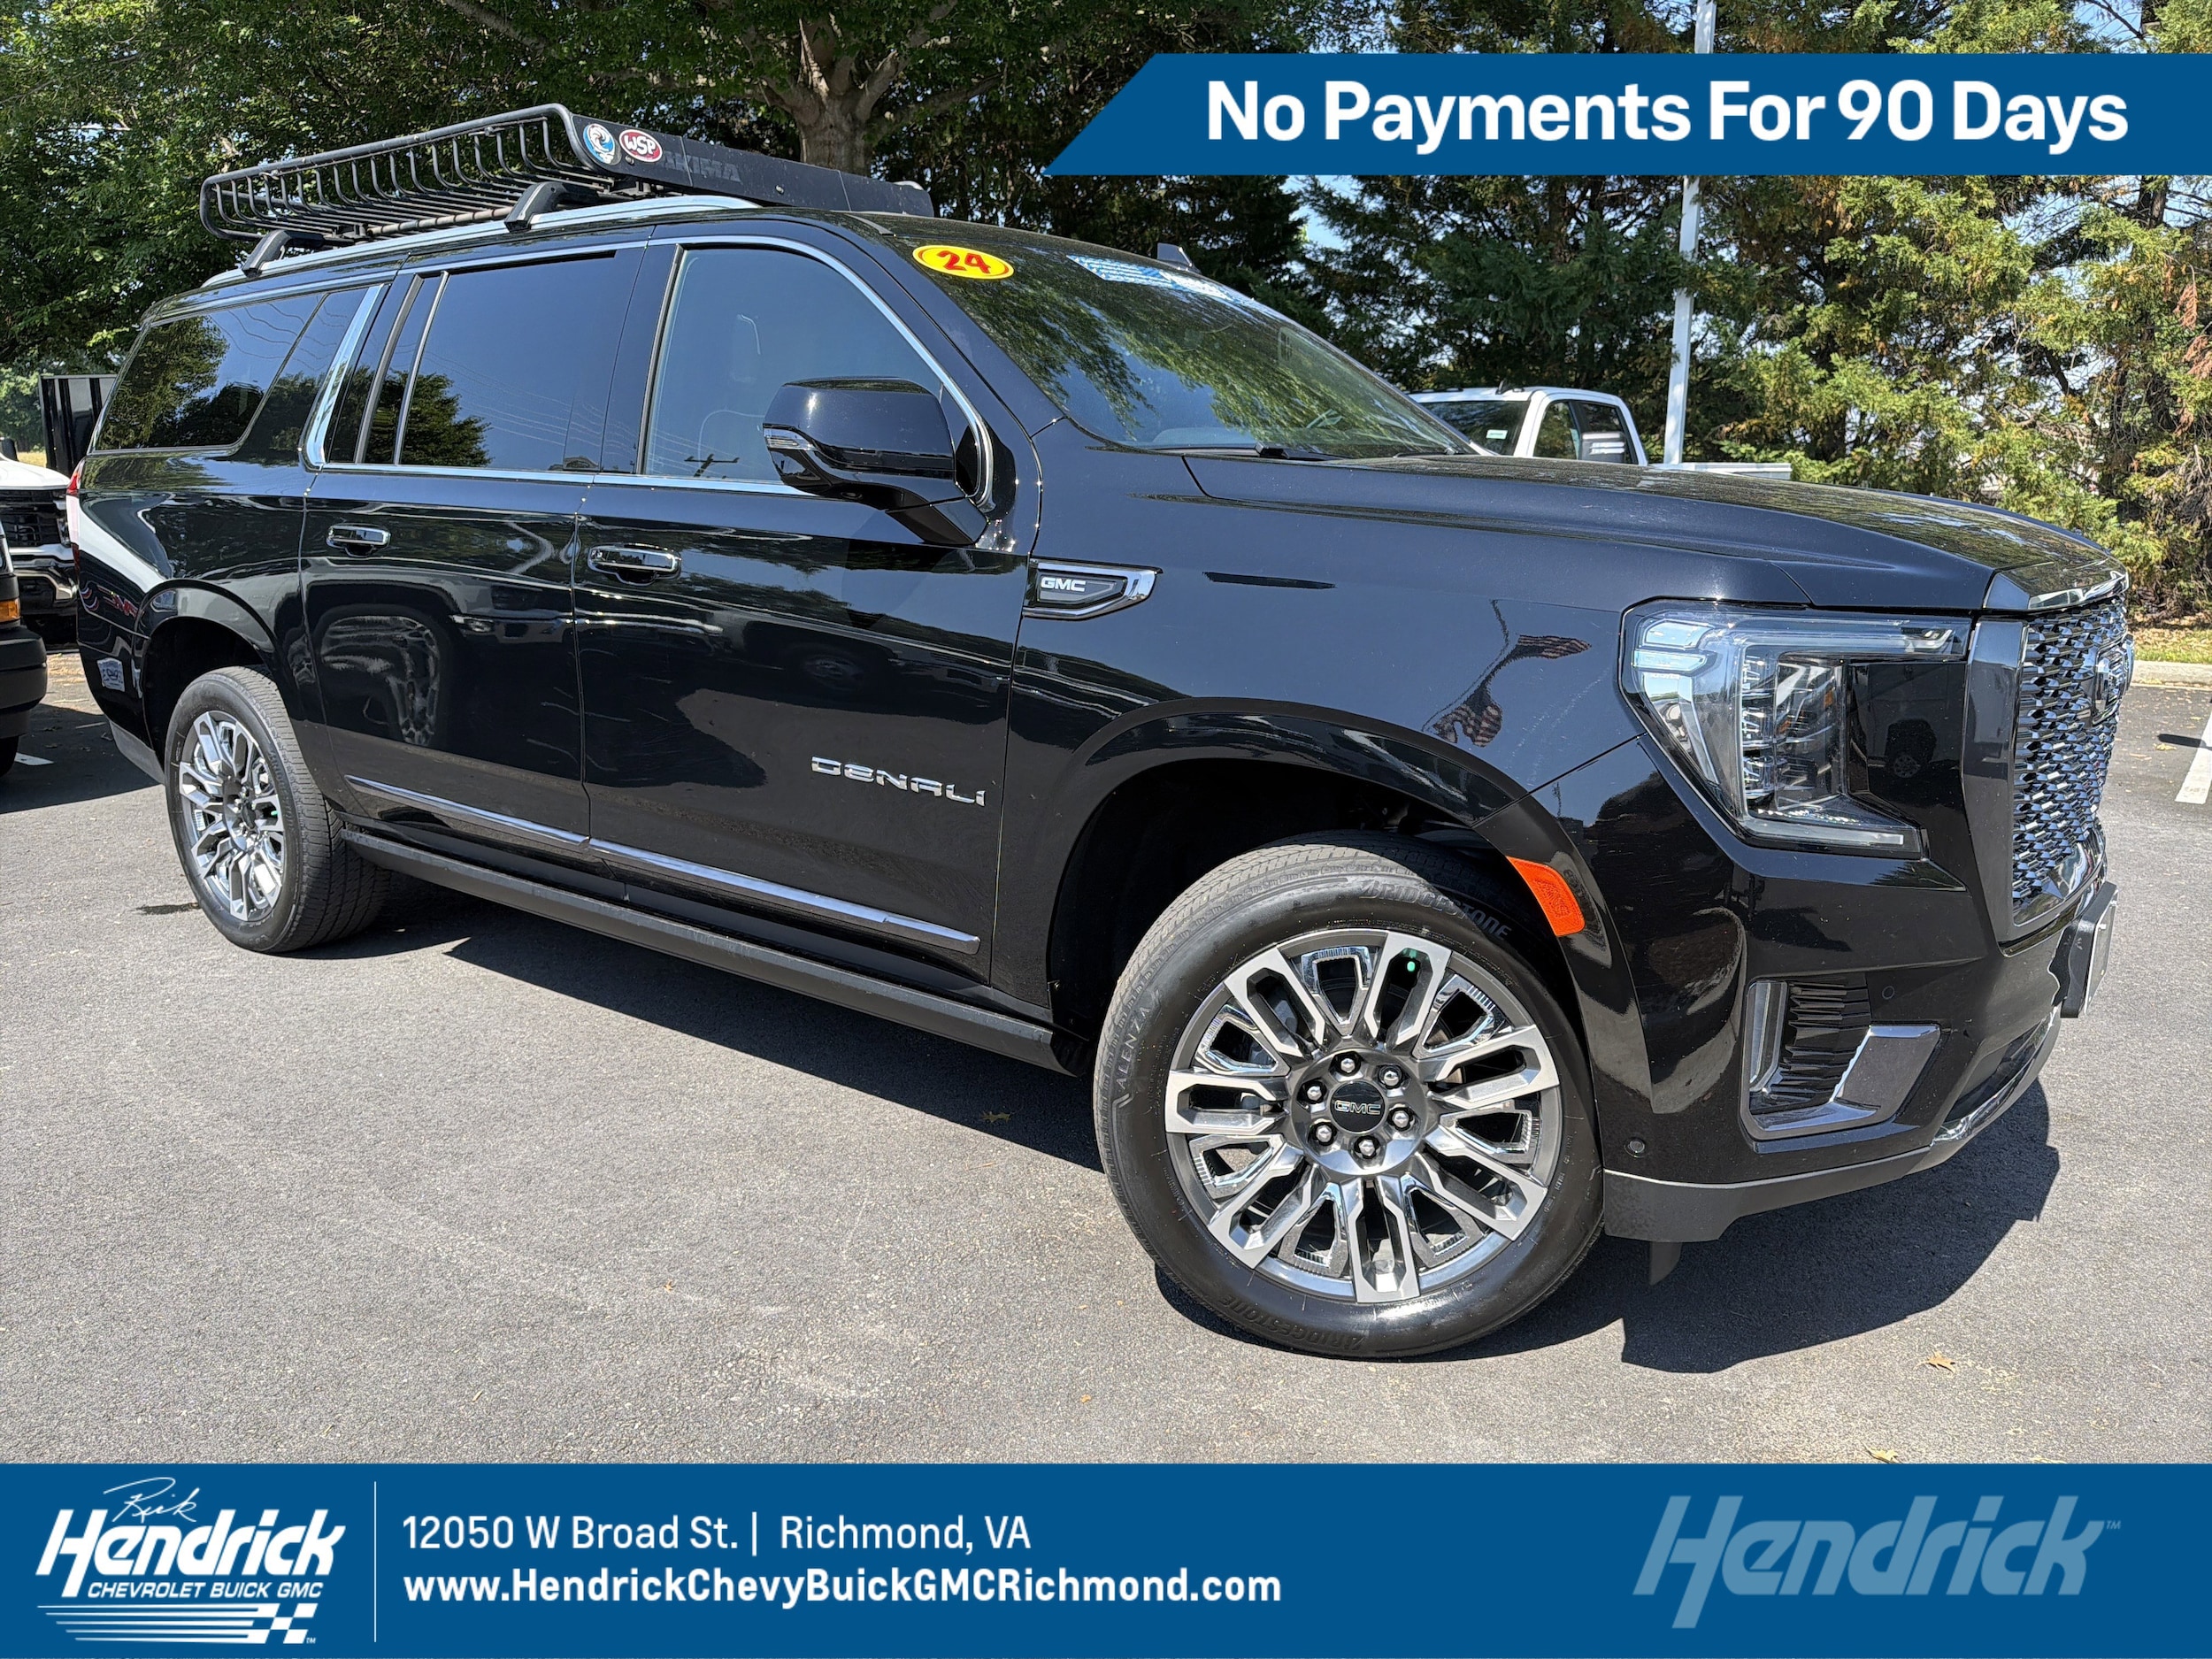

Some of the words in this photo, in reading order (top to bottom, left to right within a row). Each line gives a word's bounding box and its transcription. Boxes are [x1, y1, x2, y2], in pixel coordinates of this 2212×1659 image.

[624, 134, 657, 157] WSP
[937, 250, 991, 274] 24
[1041, 576, 1087, 592] GMC
[811, 756, 986, 807] DENALI
[1116, 1007, 1150, 1090] ALENZA
[1334, 1100, 1381, 1115] GMC
